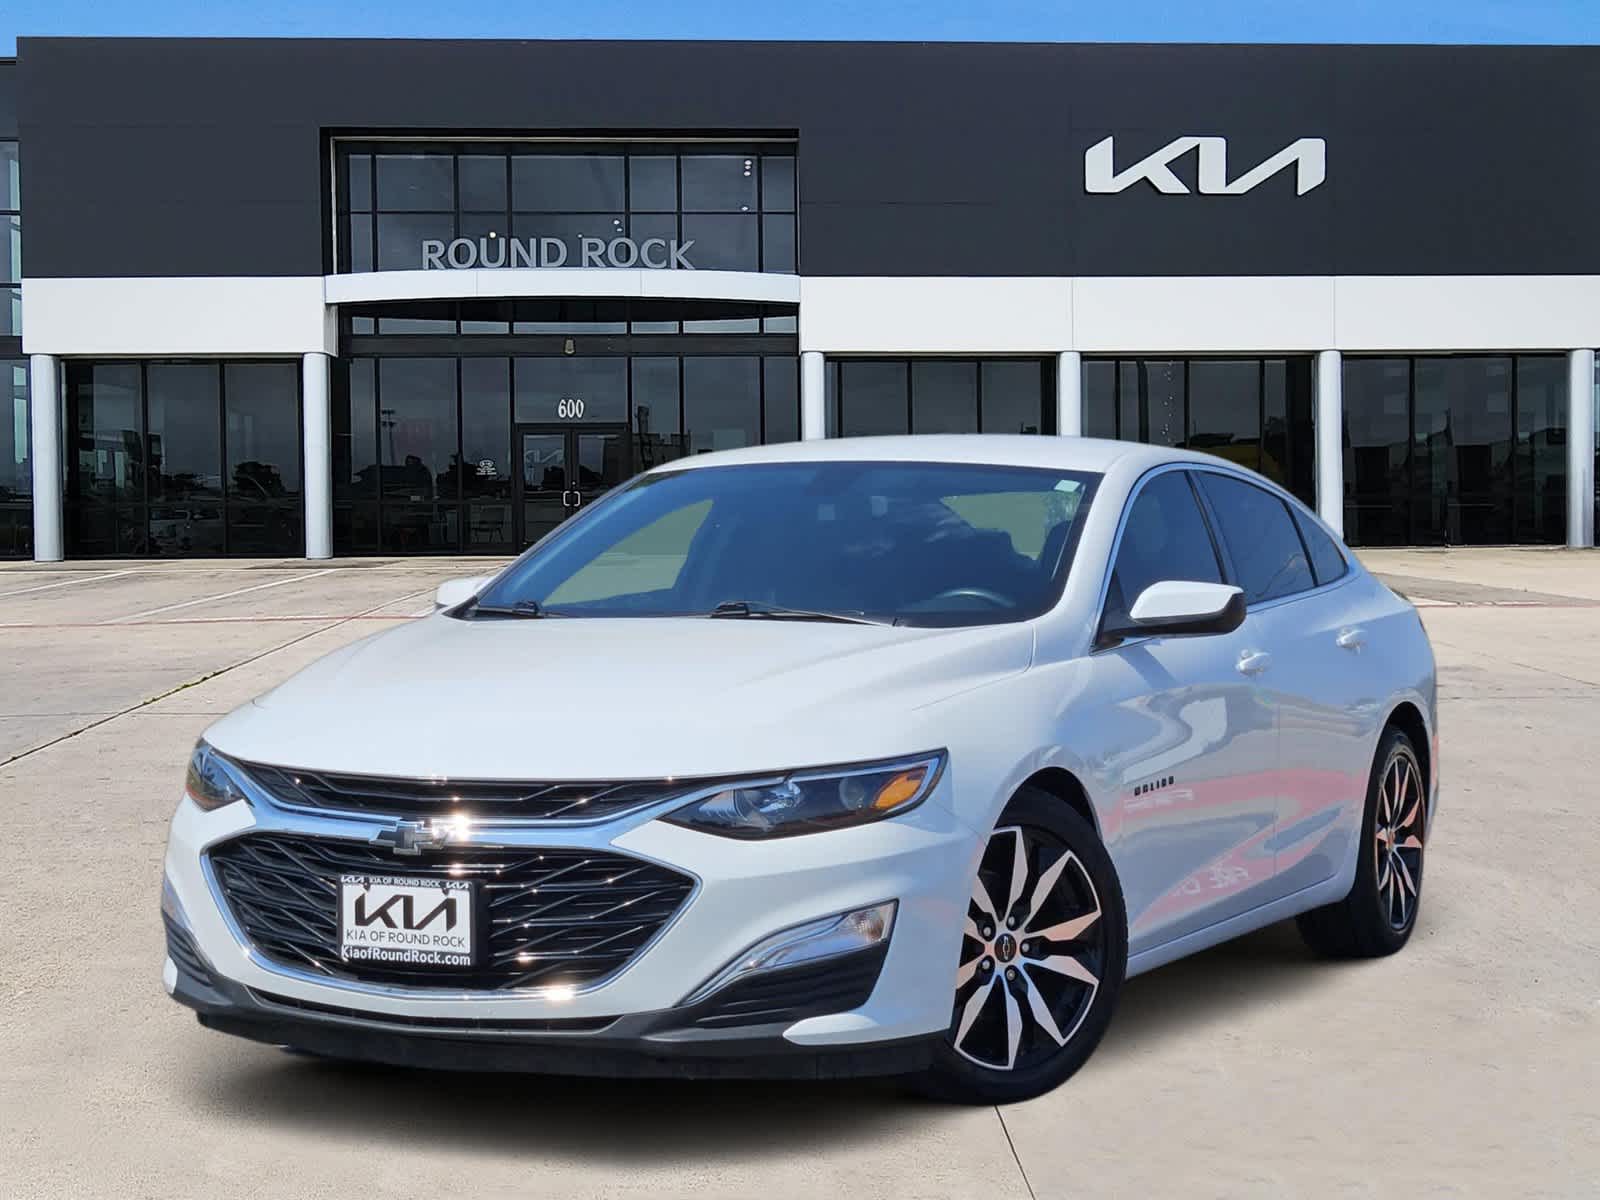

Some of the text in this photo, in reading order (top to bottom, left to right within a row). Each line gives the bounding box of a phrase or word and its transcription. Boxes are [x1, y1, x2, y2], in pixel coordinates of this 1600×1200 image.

[1085, 135, 1326, 196] KIA
[421, 237, 696, 270] ROUND ROCK
[558, 399, 584, 418] 600
[341, 875, 364, 883] KIA
[369, 876, 441, 888] KIA OF ROUND ROCK
[446, 882, 470, 890] KIA
[355, 893, 456, 932] KIA
[346, 928, 465, 948] KIA OF ROUND ROCK
[341, 945, 471, 966] KiaofRoundRock.com
